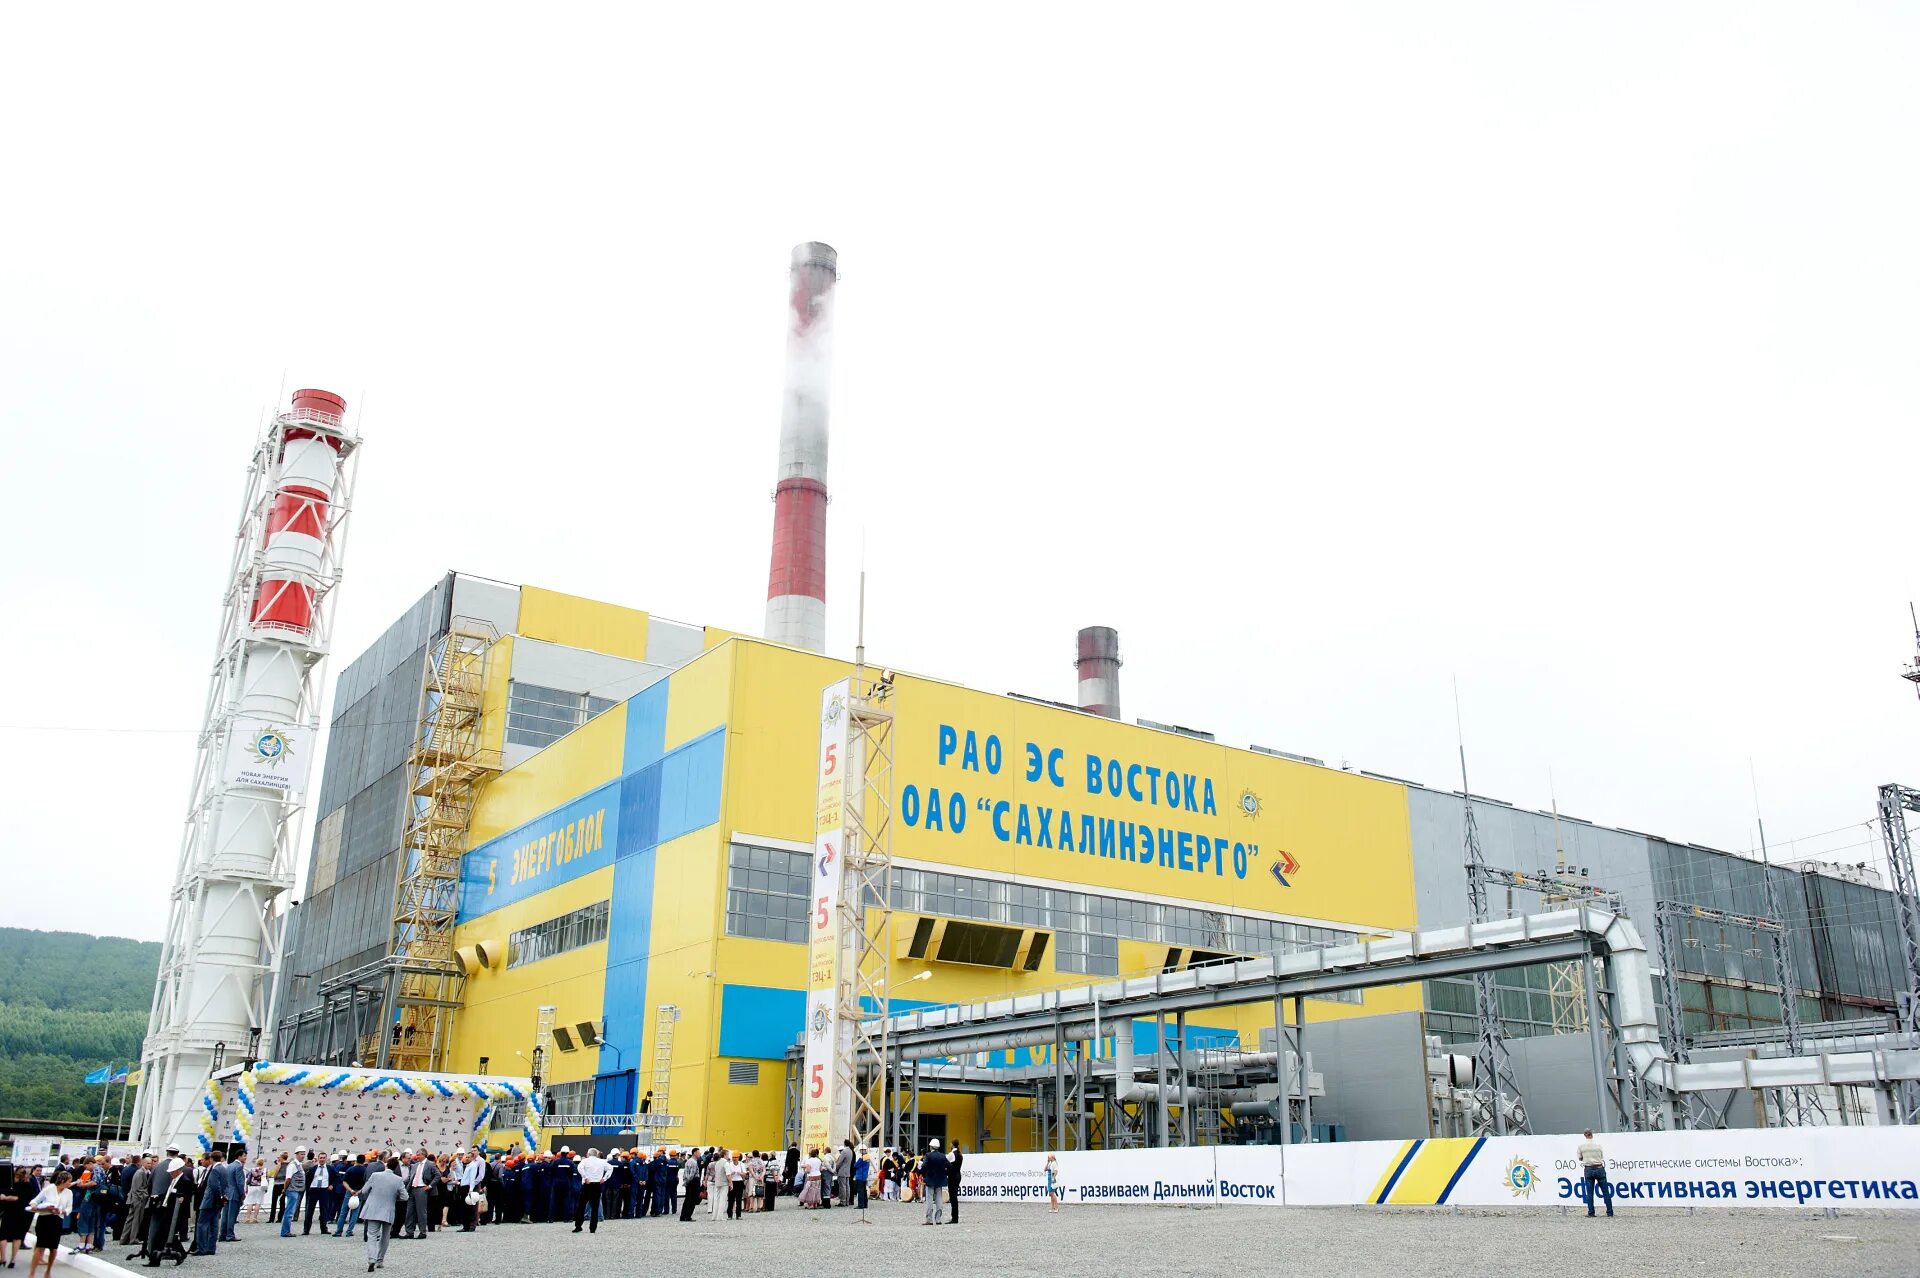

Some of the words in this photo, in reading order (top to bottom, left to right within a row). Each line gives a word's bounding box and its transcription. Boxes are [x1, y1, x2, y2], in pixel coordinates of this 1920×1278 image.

[825, 744, 837, 775] 5
[939, 724, 1002, 775] РАО
[1026, 743, 1065, 787] ЭС
[1086, 754, 1217, 817] ВОСТОКА
[235, 776, 249, 784] ДЛЯ
[819, 812, 839, 825] ТЭЦ-1
[902, 784, 967, 834] ОАО
[487, 859, 497, 896] 5
[511, 808, 605, 886] ЭНЕРГОБЛОК
[817, 896, 829, 929] 5
[812, 969, 832, 982] ТЭЦ-1
[811, 1064, 824, 1098] 5
[1554, 1160, 1577, 1170] ОАО
[1609, 1158, 1692, 1172] Энергетические
[1695, 1158, 1741, 1168] системы
[1745, 1156, 1803, 1168] Востока»:
[957, 1185, 998, 1197] азвивая
[1080, 1184, 1149, 1201] развиваем
[1153, 1179, 1215, 1200] Дальний
[1220, 1180, 1276, 1198] Восток
[1744, 1179, 1919, 1205] энергетика
